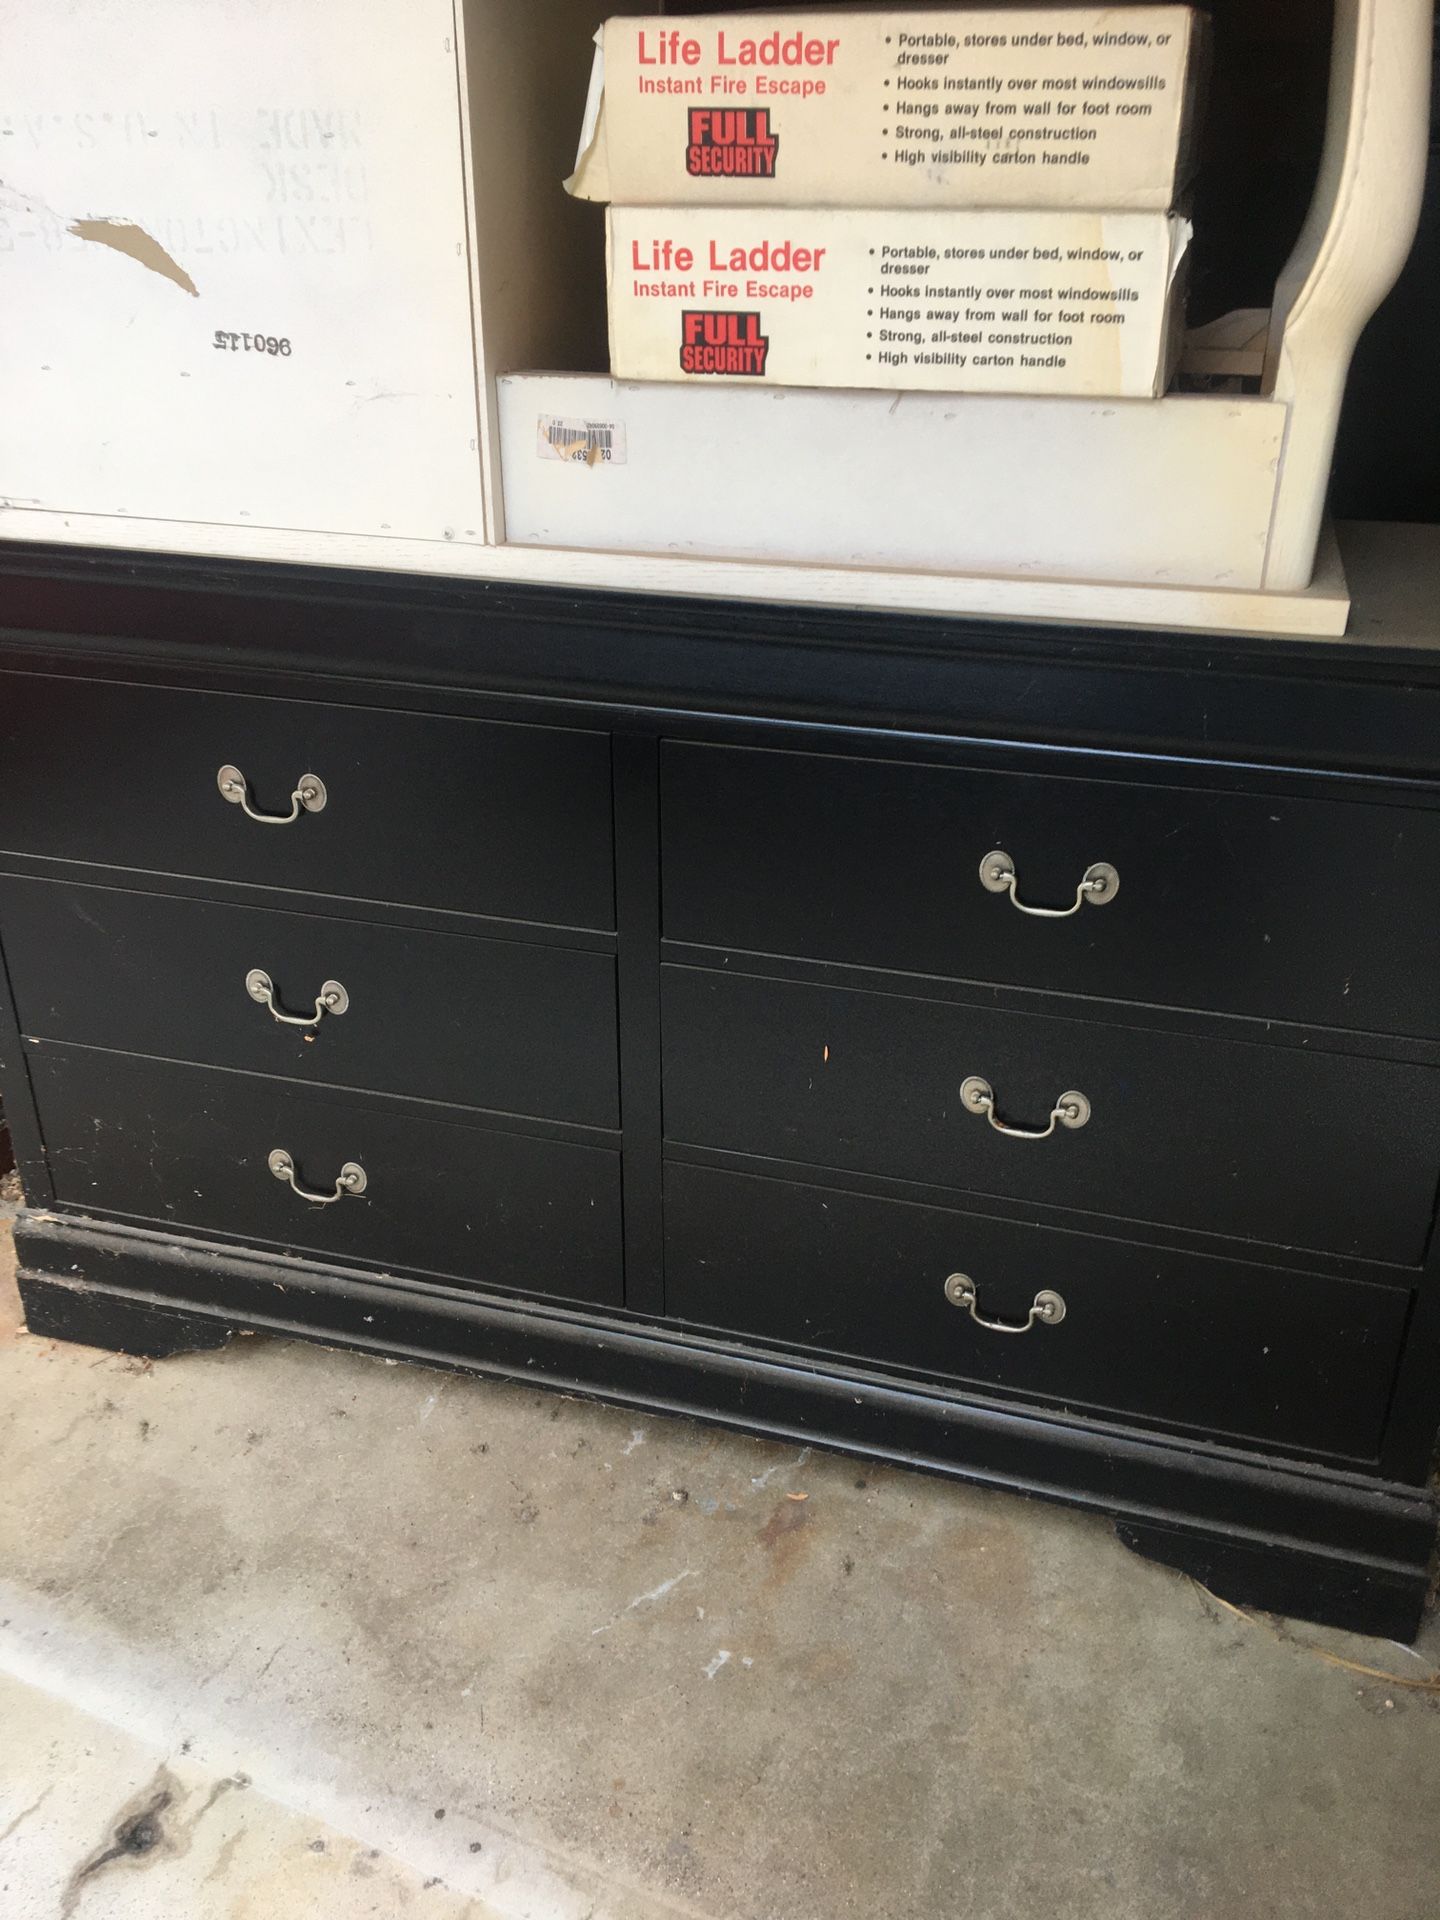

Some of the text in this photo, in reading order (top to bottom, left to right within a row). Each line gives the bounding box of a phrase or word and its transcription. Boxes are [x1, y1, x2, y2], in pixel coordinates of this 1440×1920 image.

[639, 31, 840, 65] Life Ladder
[899, 32, 1171, 48] Portable, stores under bed, window, or
[896, 51, 949, 65] dresser
[640, 76, 825, 97] Instant Fire Escape
[898, 76, 1165, 93] Hooks instantly over most windowsills
[897, 101, 1152, 117] Hangs away from wall for foot room
[691, 110, 775, 145] FULL
[896, 125, 1096, 142] Strong, all-steel construction
[689, 146, 775, 175] SECURITY
[895, 150, 1089, 166] High visibility carton handle
[633, 240, 825, 271] Life Ladder
[882, 246, 1143, 262] Portable, stores under bed, window, or
[881, 262, 930, 275] dresser
[634, 281, 812, 300] Instant Fire Escape
[881, 285, 1138, 301] Hooks instantly over most windowsills
[880, 307, 1125, 324] Hangs away from wall for foot room
[685, 314, 765, 345] FULL
[880, 329, 1072, 345] Strong, all-steel construction
[212, 330, 292, 357] 960115
[683, 347, 765, 374] SECURITY
[879, 351, 1066, 367] High visibility carton handle
